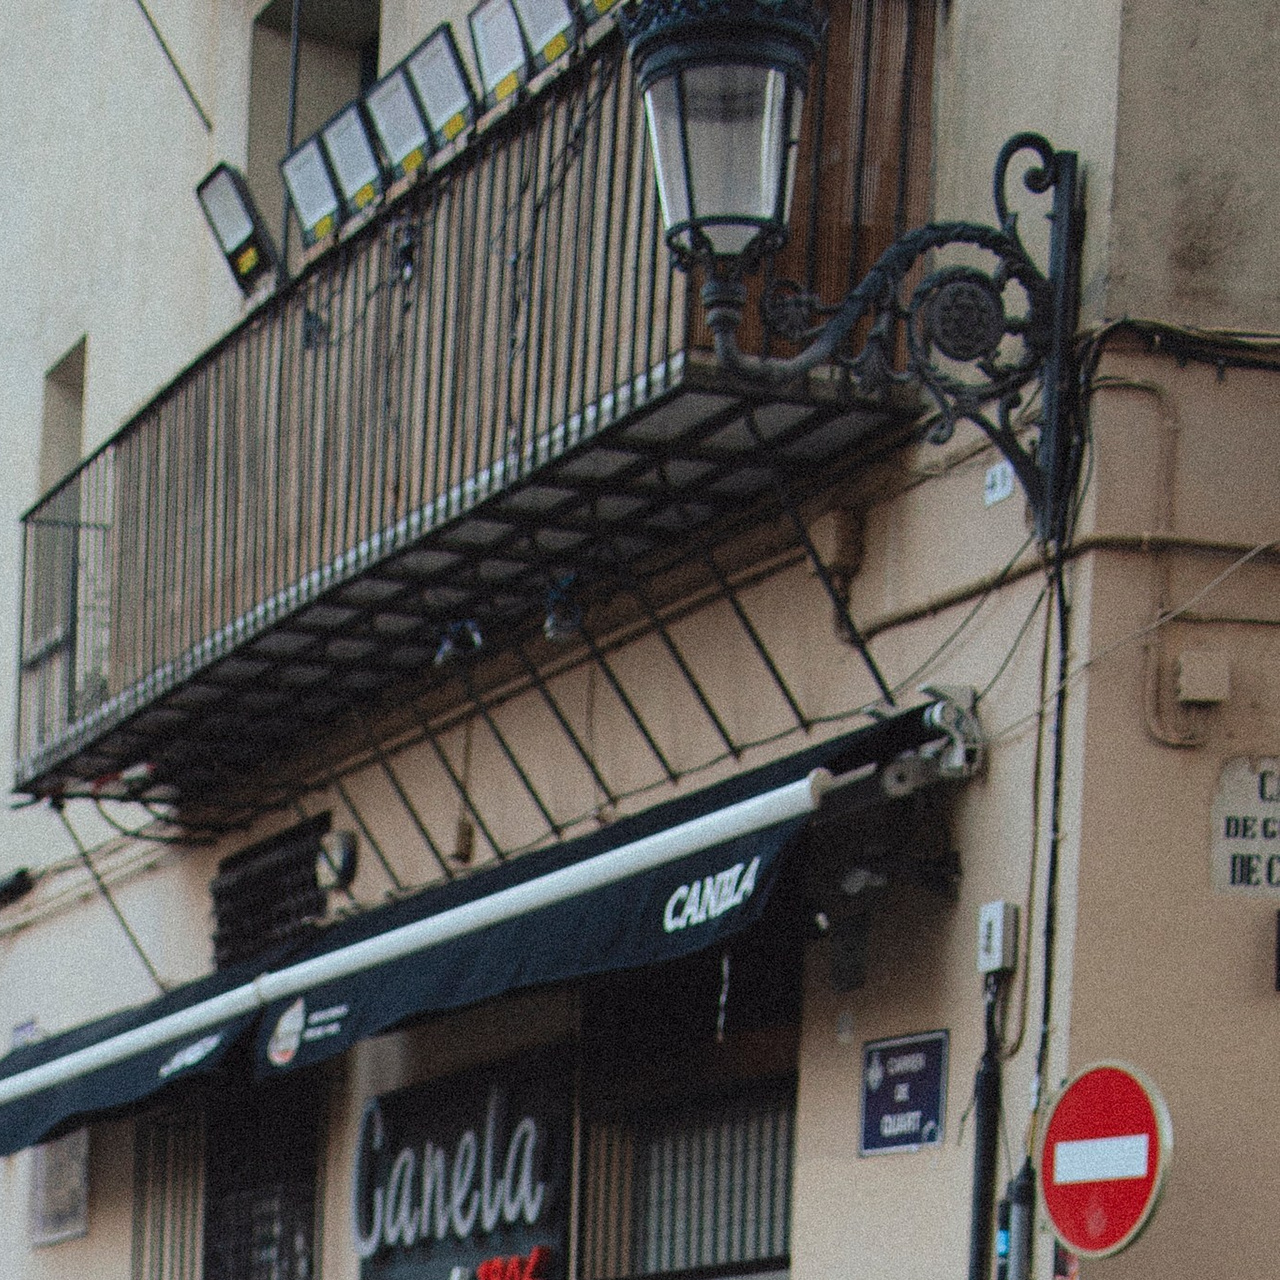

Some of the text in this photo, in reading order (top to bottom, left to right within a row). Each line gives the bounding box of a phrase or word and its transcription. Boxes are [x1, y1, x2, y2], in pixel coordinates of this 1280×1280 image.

[1225, 815, 1258, 839] DE
[1230, 853, 1261, 886] DE
[351, 1084, 545, 1258] Canela
